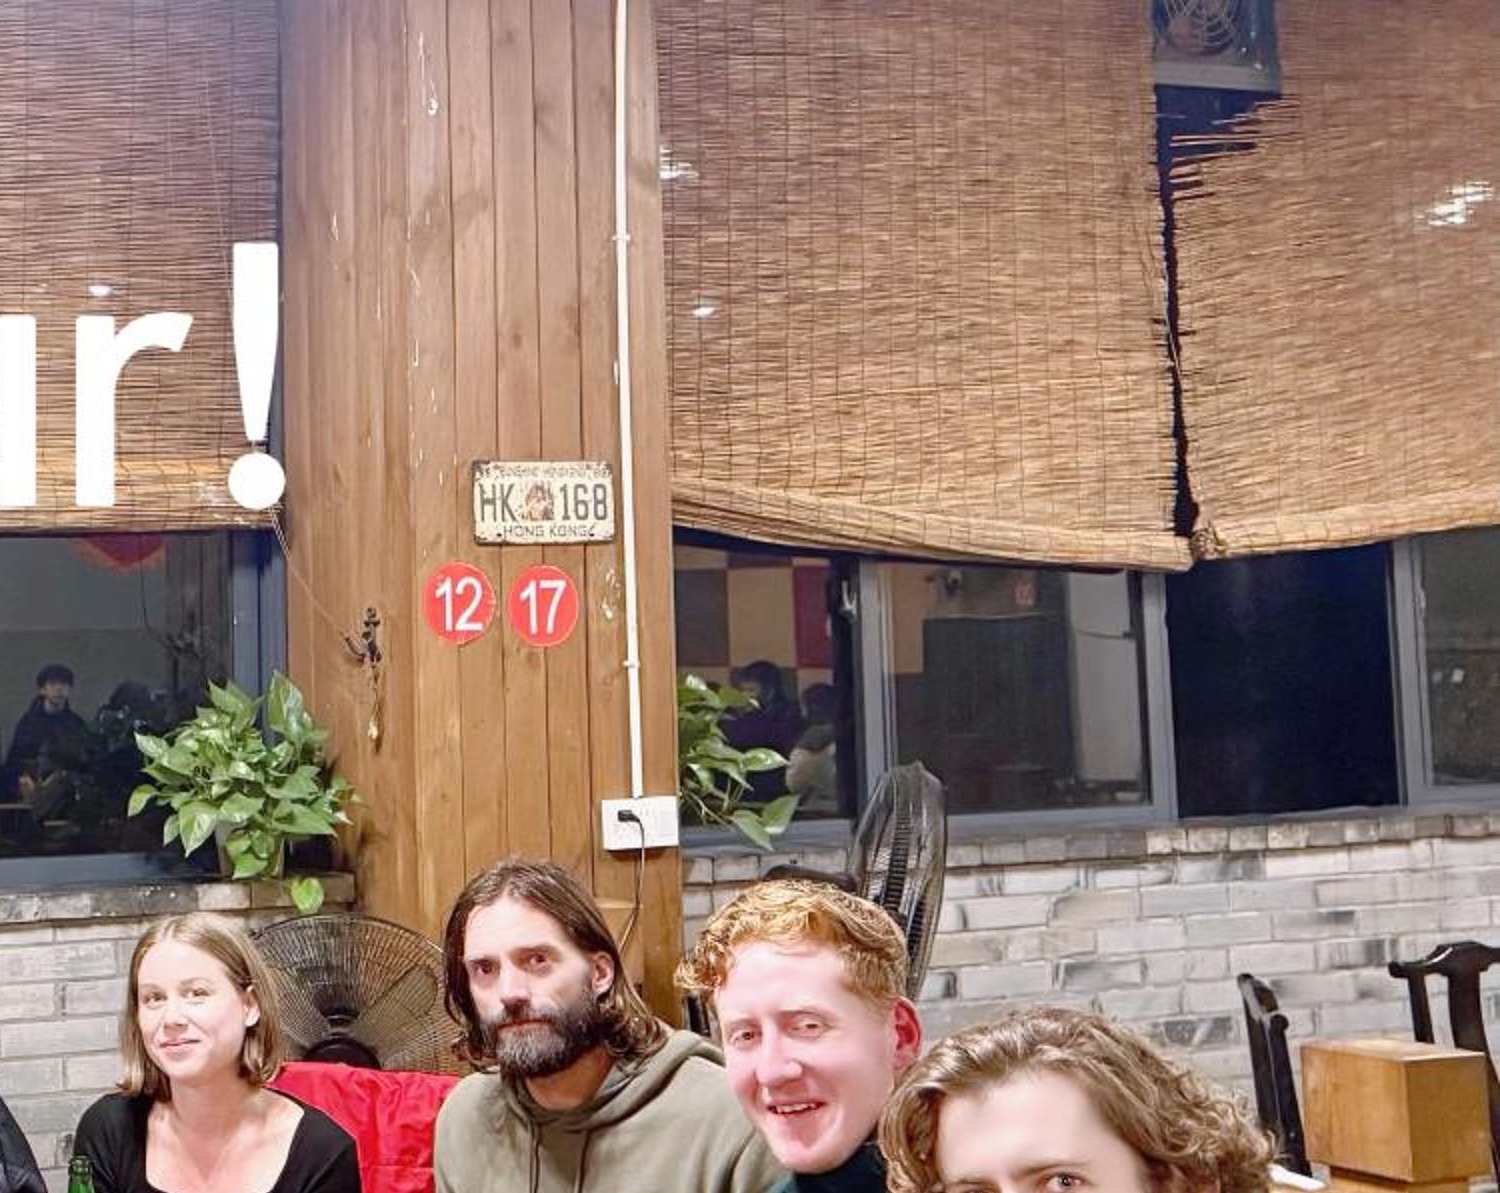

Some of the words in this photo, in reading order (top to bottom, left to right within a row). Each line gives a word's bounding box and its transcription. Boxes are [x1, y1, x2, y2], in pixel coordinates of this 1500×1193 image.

[479, 483, 518, 522] HK
[560, 483, 607, 521] 168
[503, 525, 545, 537] HONG
[549, 525, 589, 537] KONG
[435, 577, 485, 632] 12
[519, 579, 567, 634] 17
